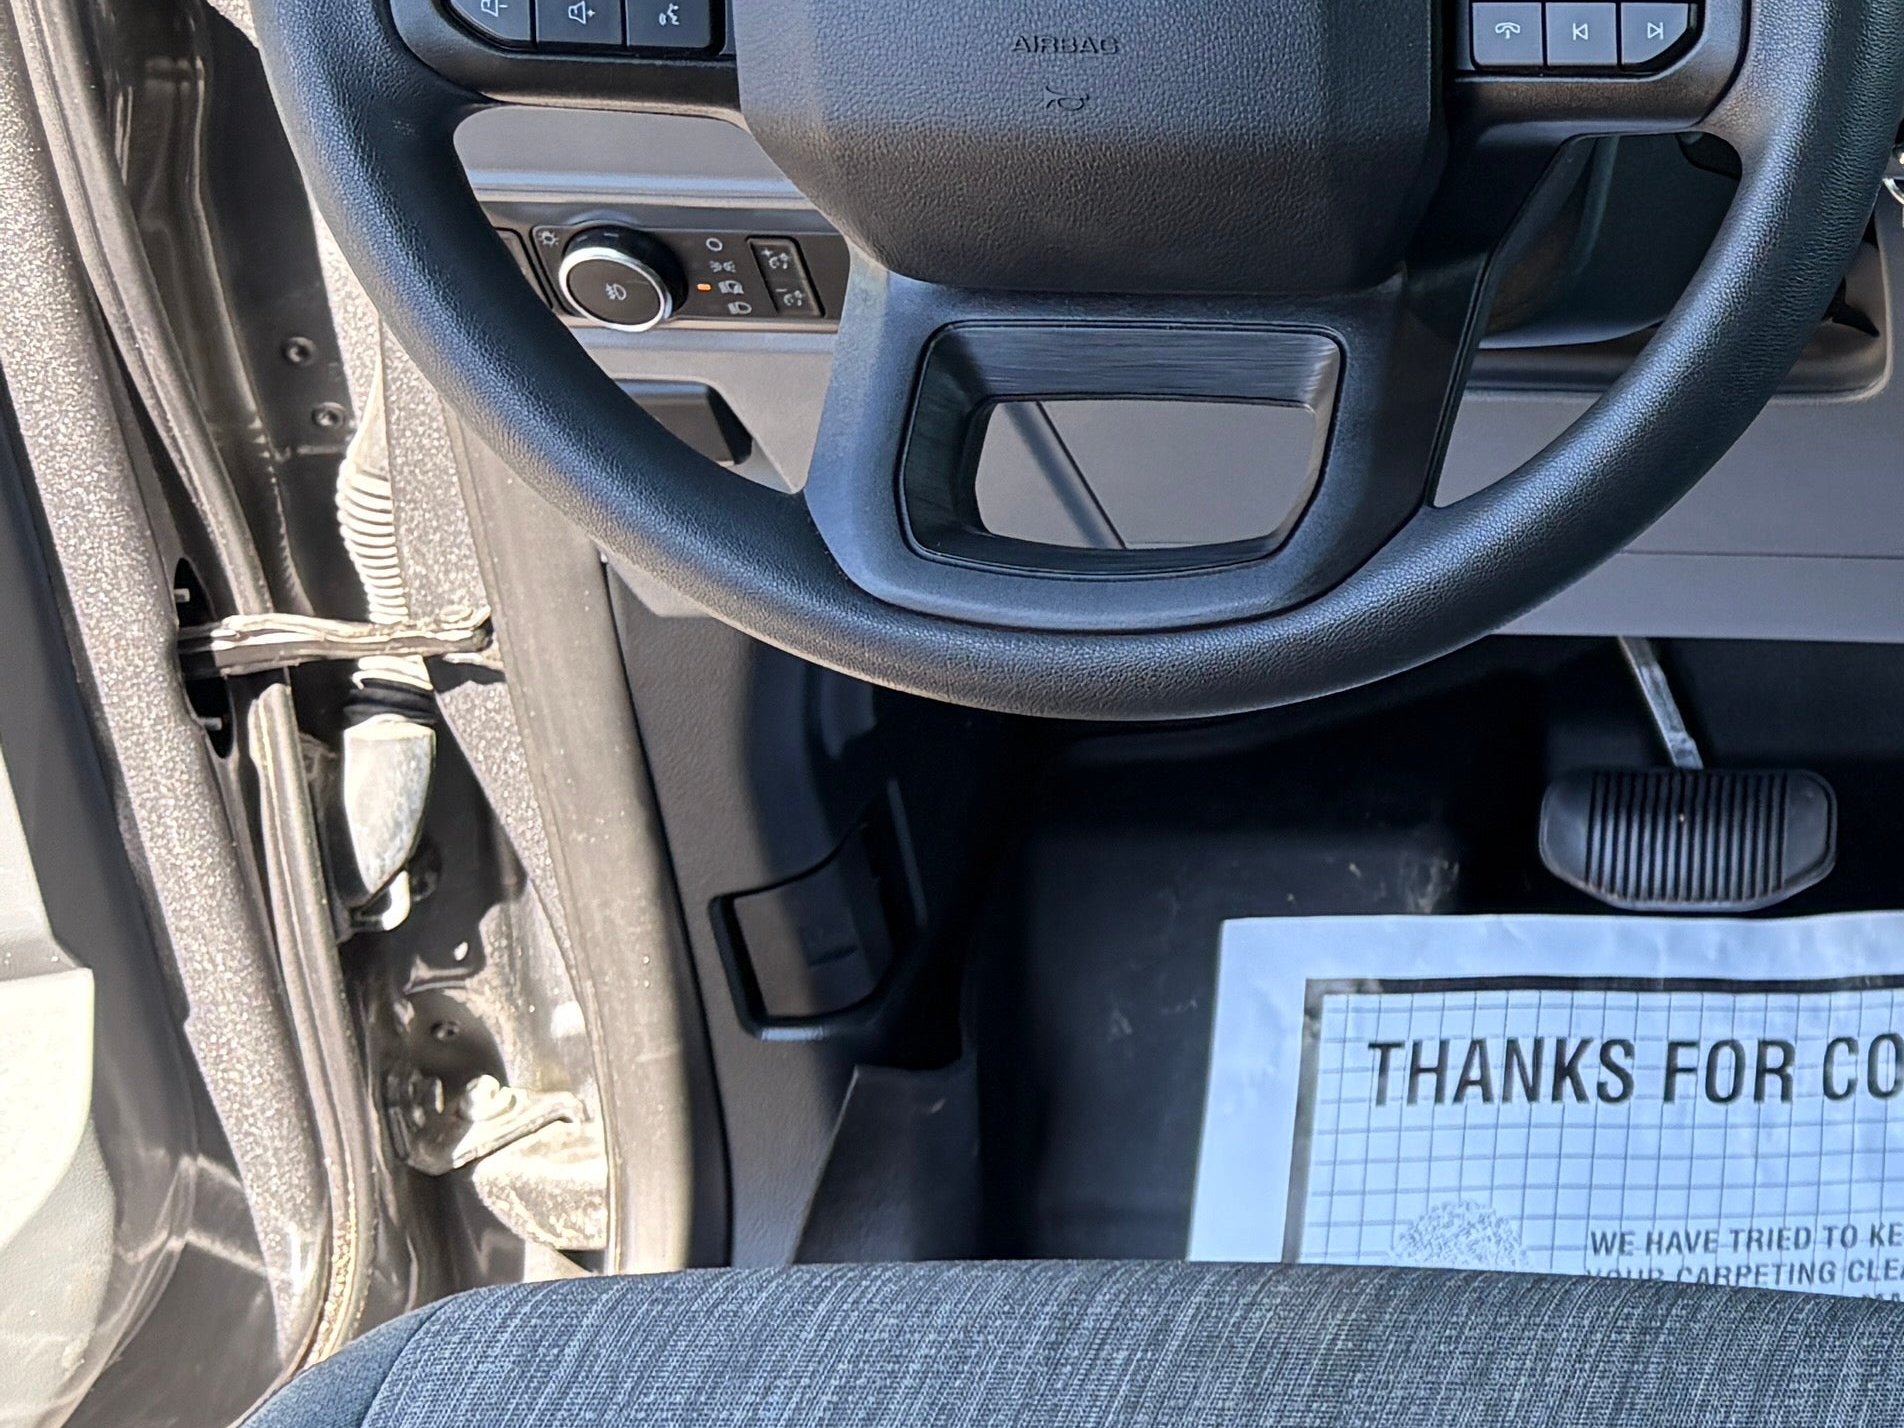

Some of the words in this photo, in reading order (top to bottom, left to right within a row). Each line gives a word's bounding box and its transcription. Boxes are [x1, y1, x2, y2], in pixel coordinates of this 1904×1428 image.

[1367, 1035, 1636, 1107] THANKS
[1662, 1036, 1797, 1106] FOR
[1591, 1229, 1636, 1257] WE
[1646, 1227, 1719, 1256] HAVE
[1729, 1224, 1812, 1253] TRIED
[1822, 1223, 1859, 1251] TO
[1676, 1259, 1837, 1287] CARPETING
